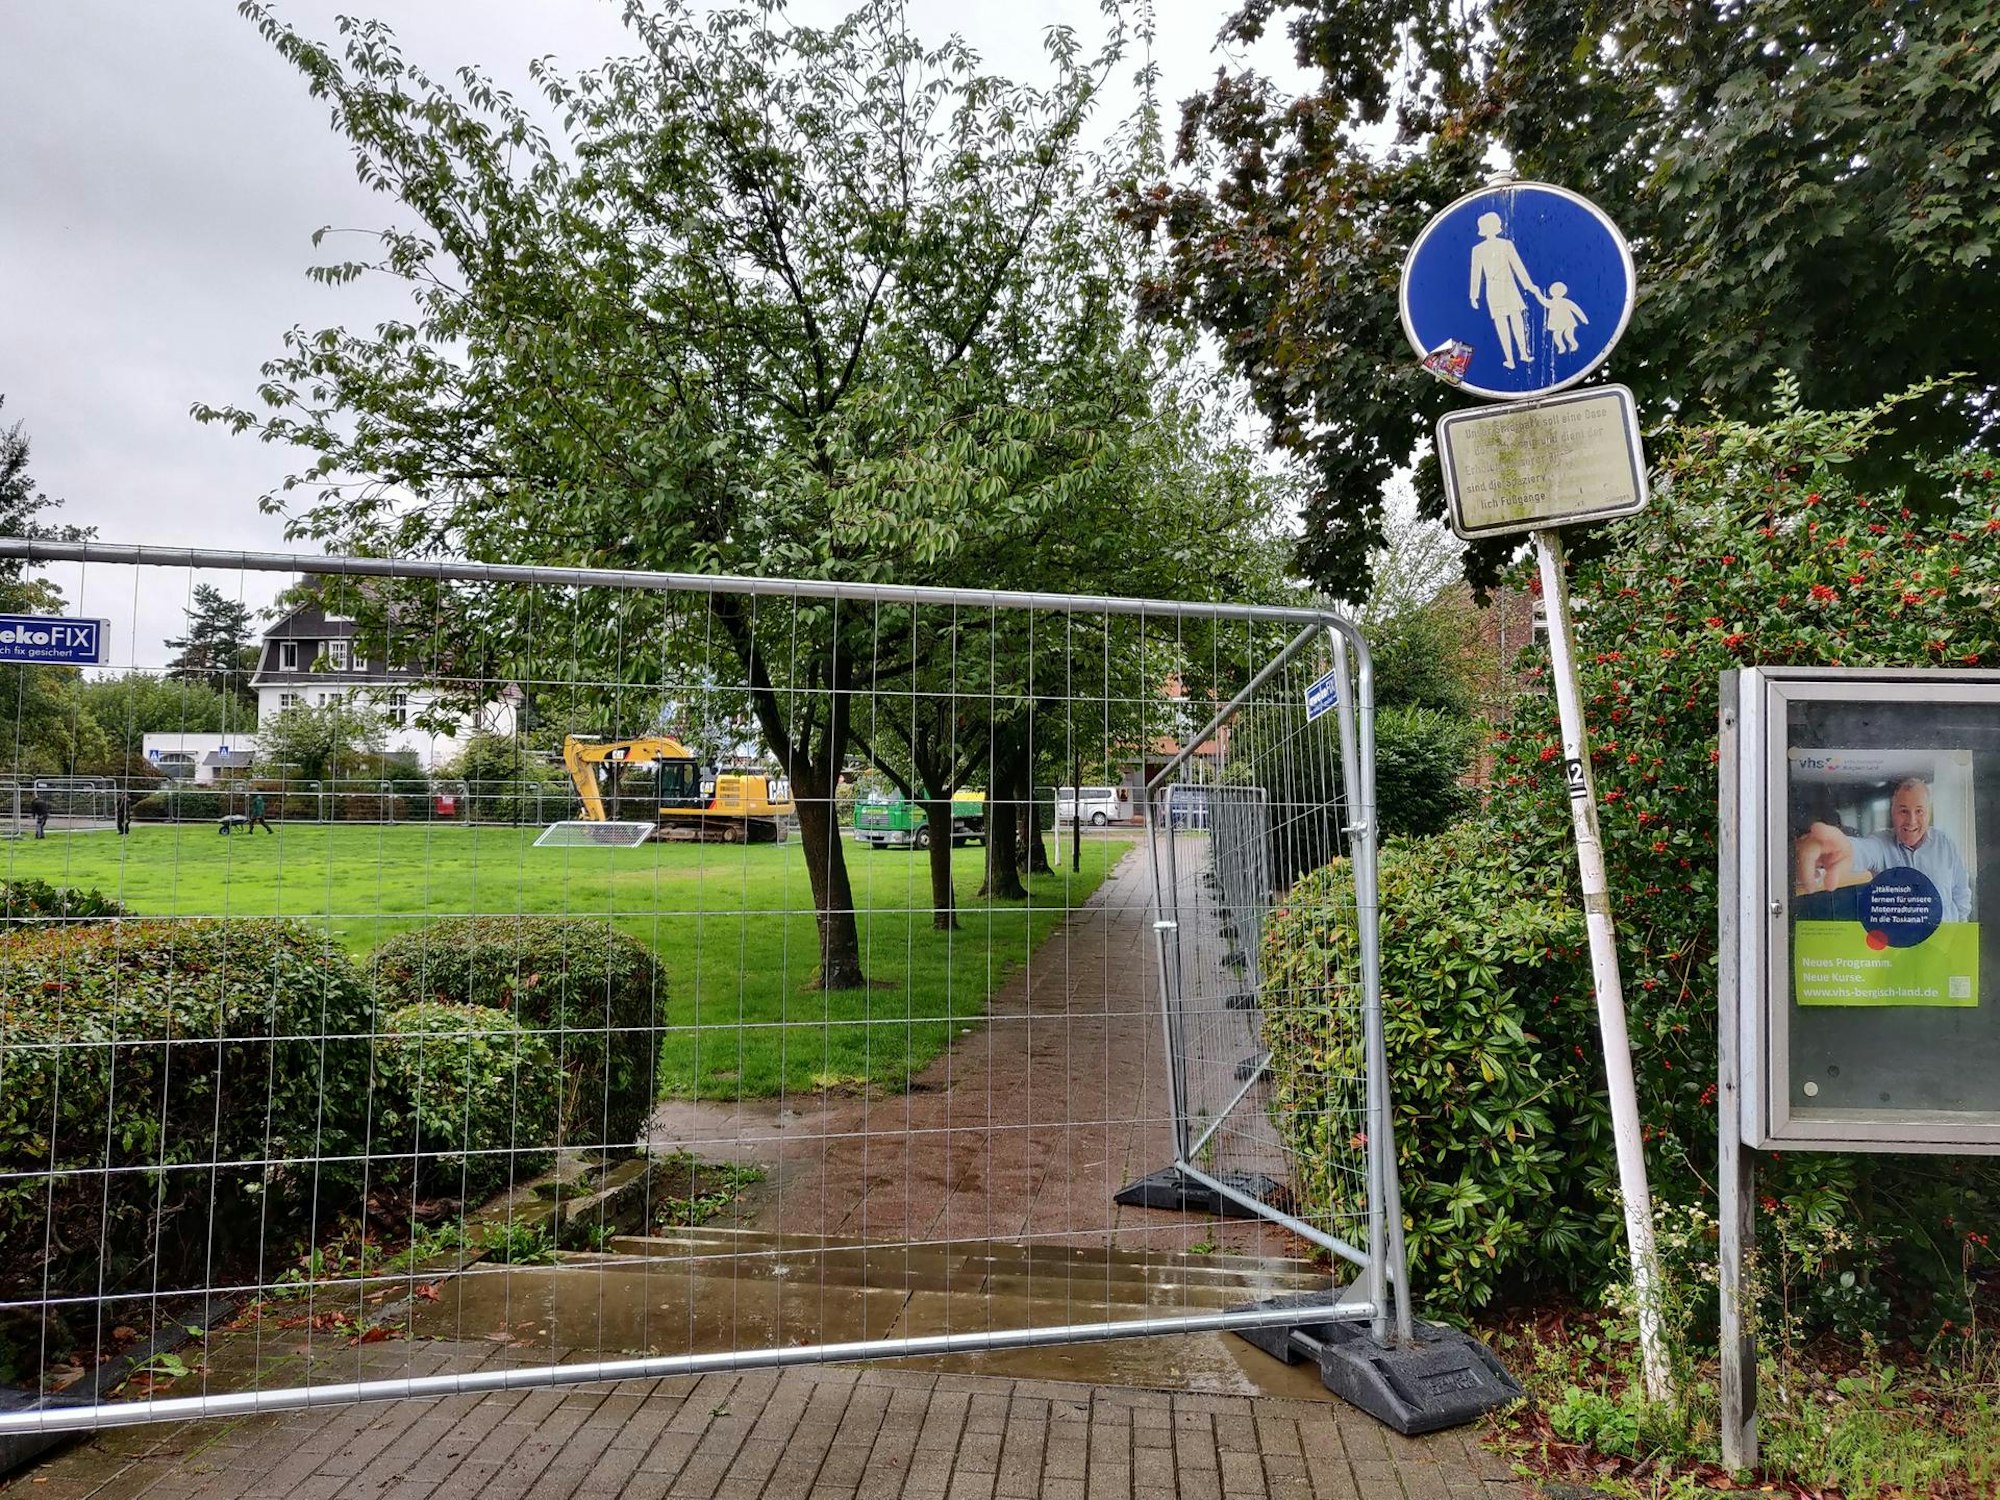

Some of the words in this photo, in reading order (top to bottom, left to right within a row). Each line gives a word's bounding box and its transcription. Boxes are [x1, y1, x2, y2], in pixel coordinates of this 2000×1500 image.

[1542, 414, 1559, 426] soll
[1561, 410, 1581, 423] eine
[1466, 481, 1485, 493] sind
[1488, 479, 1501, 489] die
[1481, 498, 1497, 509] lich
[1501, 490, 1546, 508] Fußgänge
[14, 646, 25, 655] fix
[28, 648, 73, 657] gesichert
[1800, 757, 1824, 769] vhs
[700, 781, 715, 794] CAT
[768, 780, 788, 802] CAT
[1802, 958, 1833, 967] Neues
[1836, 958, 1892, 969] Programm.
[1803, 973, 1829, 982] Neue
[1832, 973, 1865, 982] Kurse.
[1803, 987, 1939, 998] www.vhs-bergisch-land.de
